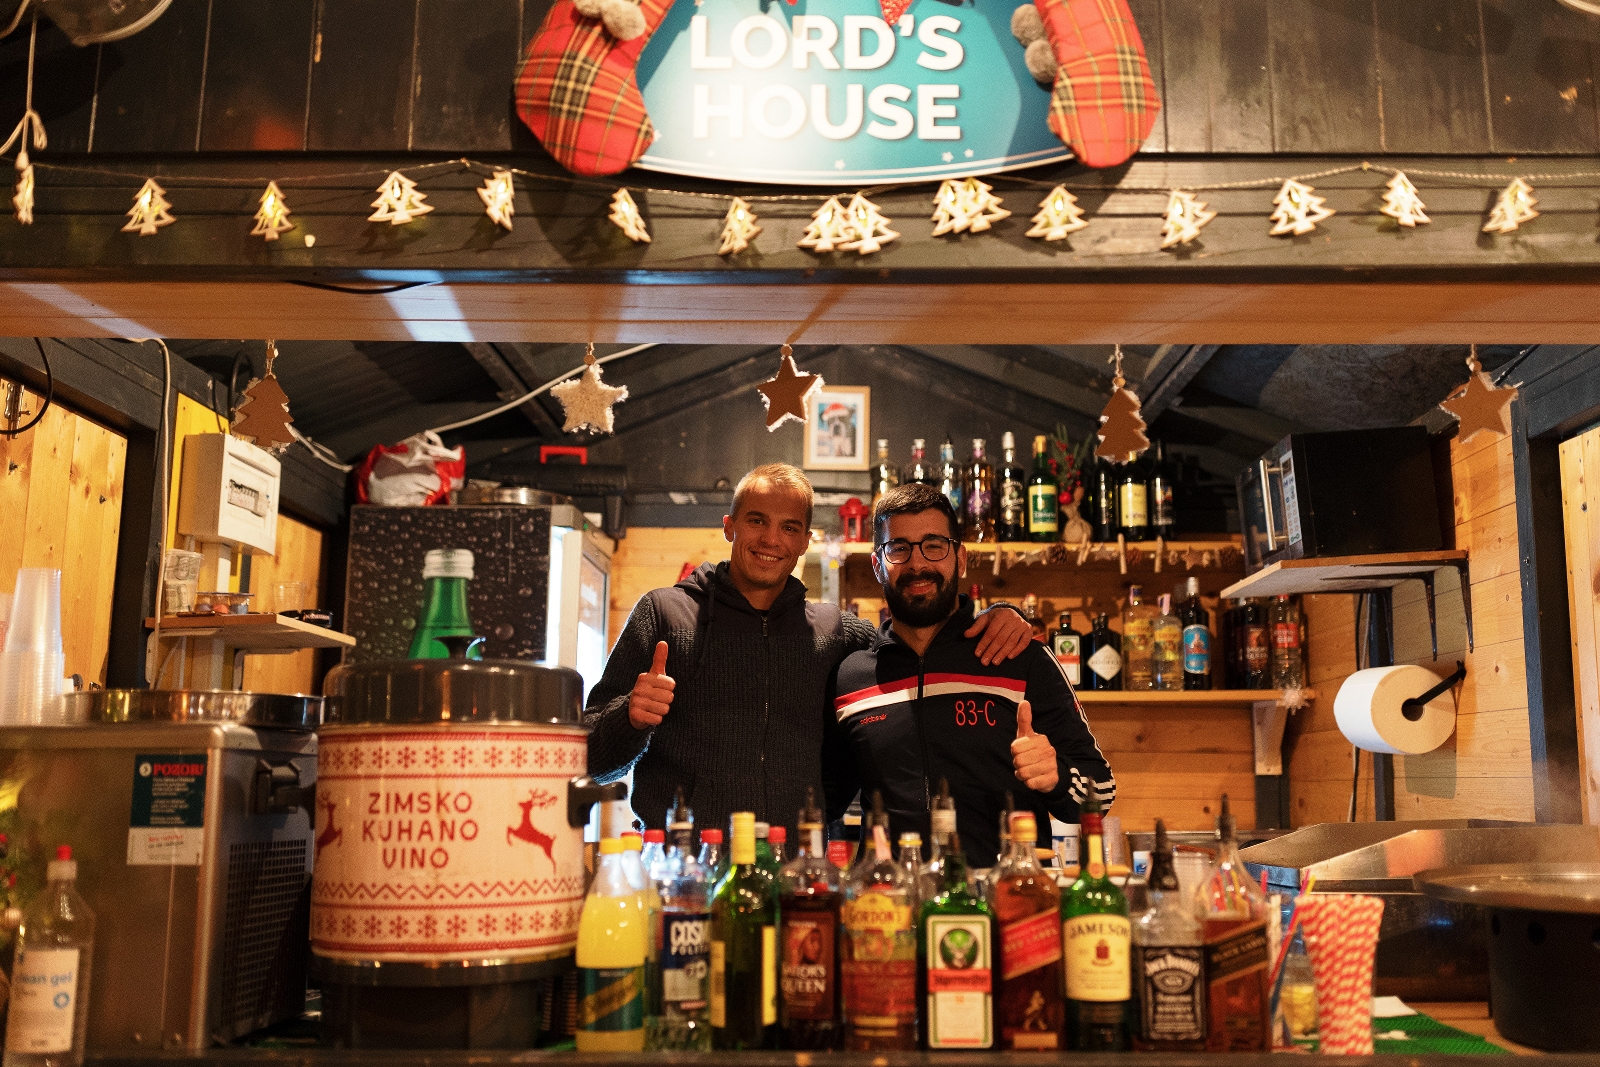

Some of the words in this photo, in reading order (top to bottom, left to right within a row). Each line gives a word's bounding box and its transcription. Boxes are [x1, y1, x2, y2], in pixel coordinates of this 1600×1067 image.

[689, 14, 965, 71] LORD'S
[692, 83, 962, 141] HOUSE
[955, 700, 997, 726] 83-C
[368, 792, 472, 814] ZIMSKO
[362, 819, 479, 843] KUHANO
